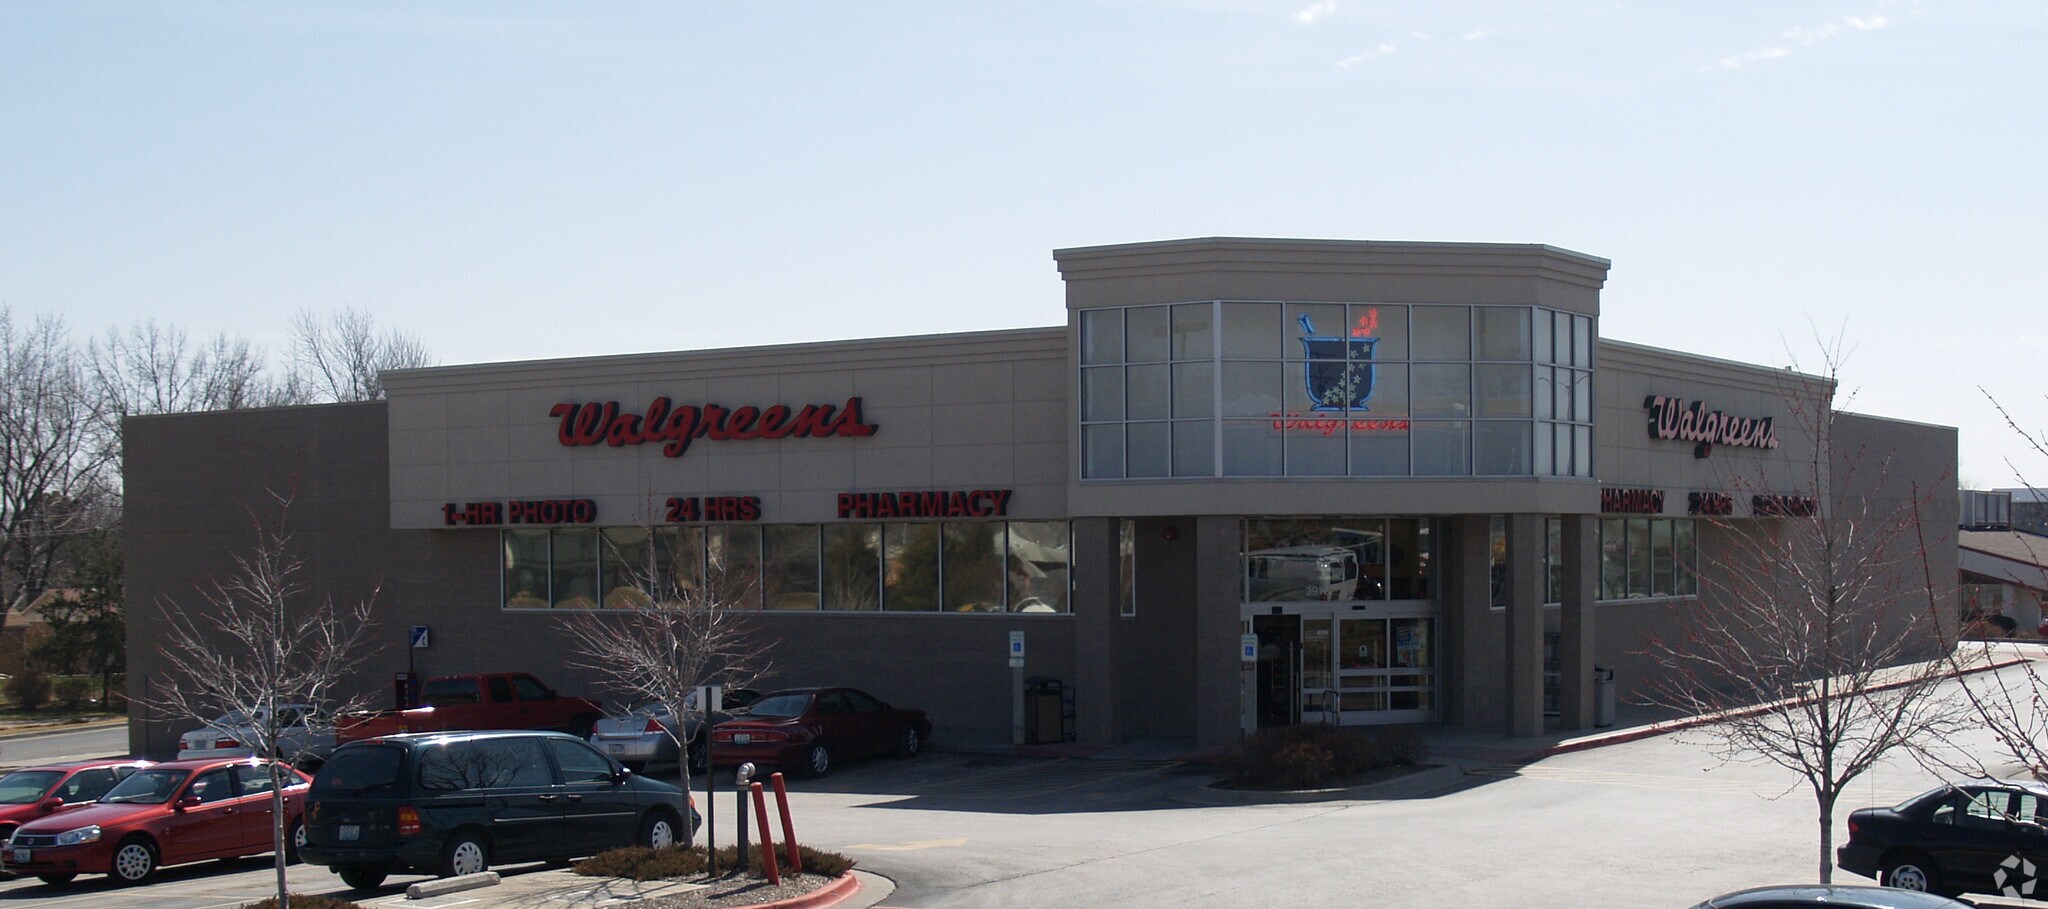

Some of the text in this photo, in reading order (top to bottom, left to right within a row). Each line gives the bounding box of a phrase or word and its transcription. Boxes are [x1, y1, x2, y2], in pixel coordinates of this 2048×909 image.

[549, 397, 879, 458] Walgreens
[1644, 395, 1779, 458] Walgreens
[441, 499, 597, 525] 1-HR PHOTO
[665, 496, 762, 522] 24 HRS
[837, 489, 1013, 517] PHARMACY
